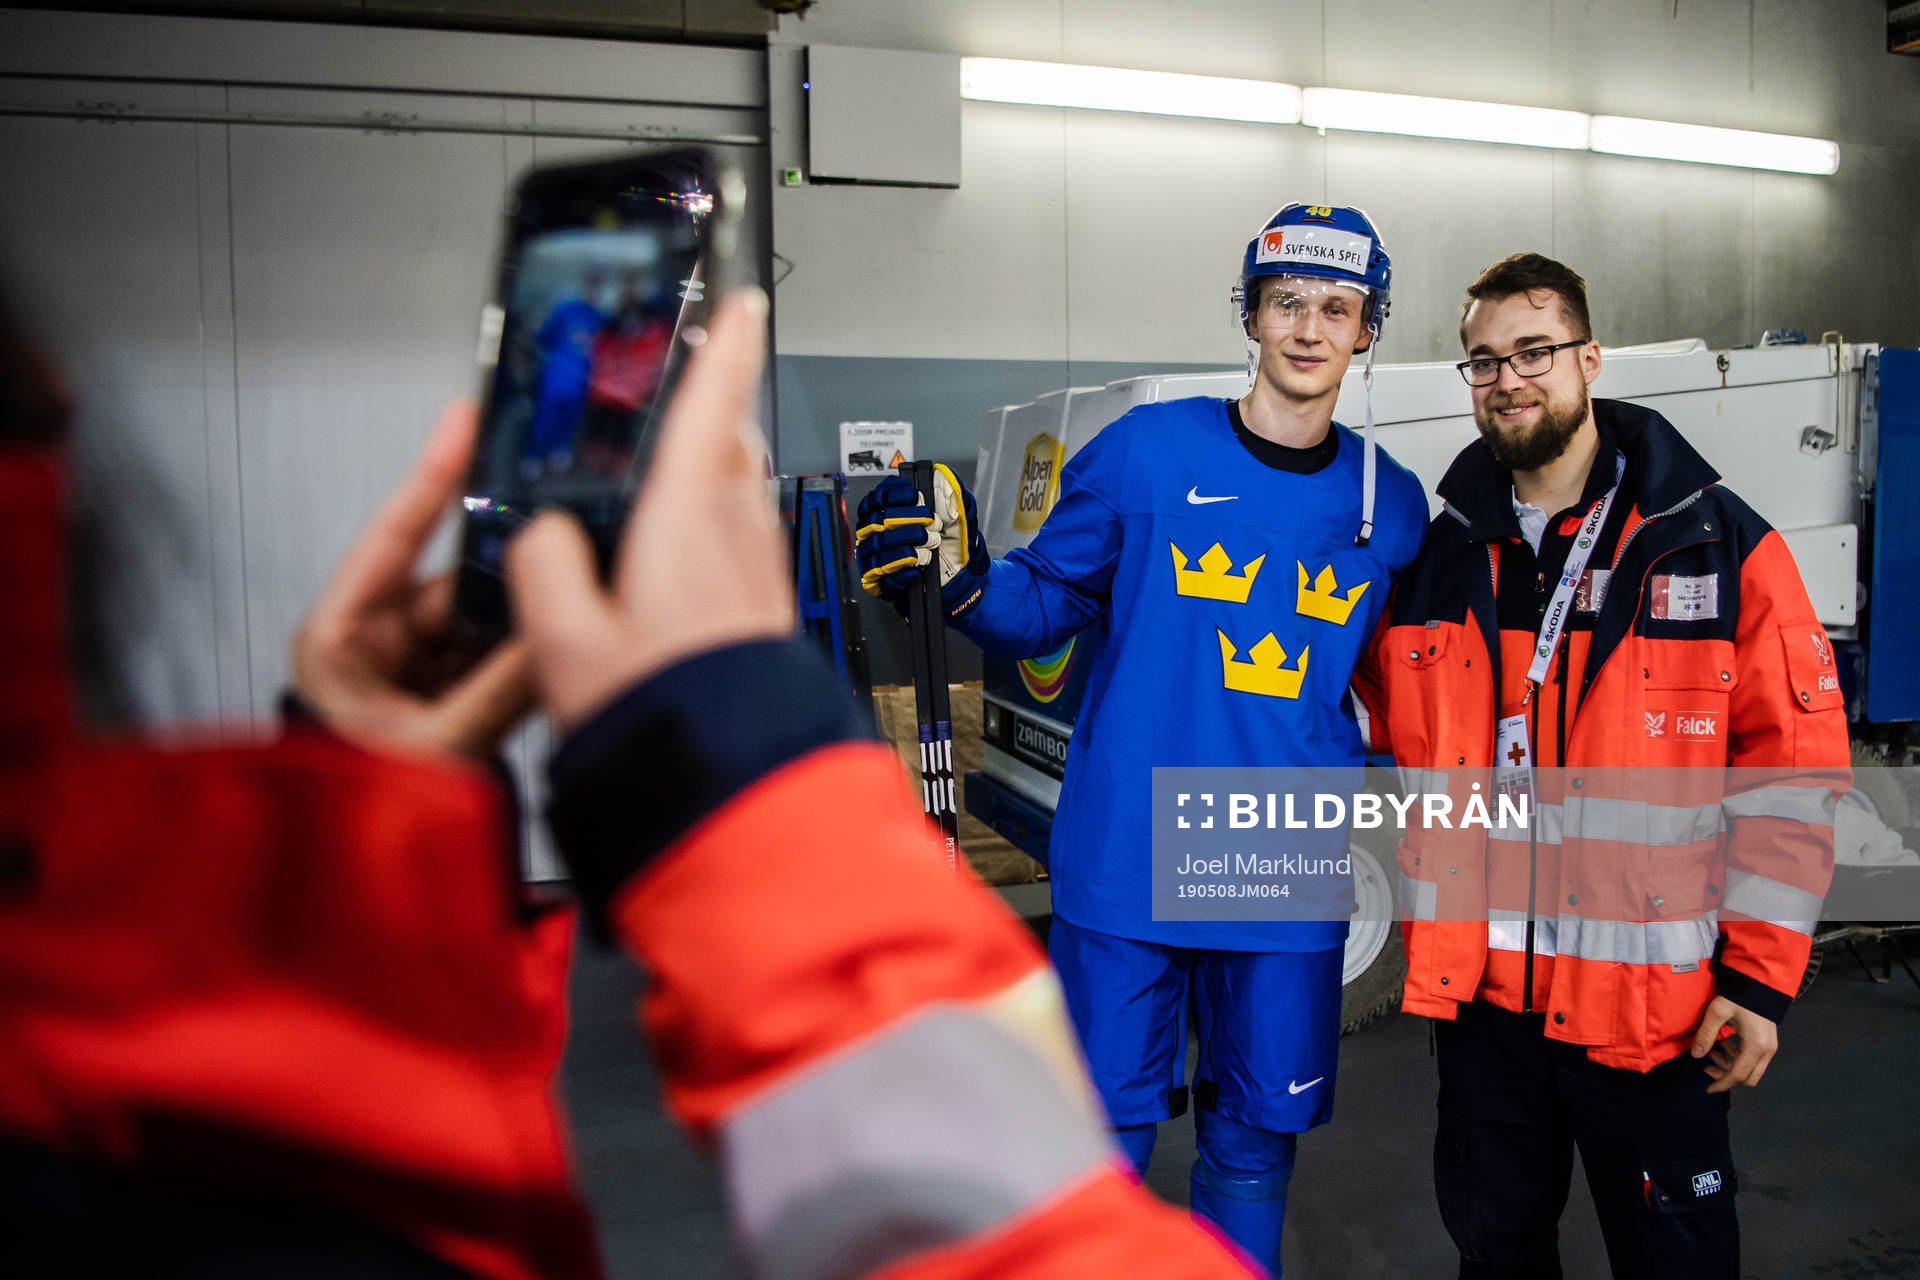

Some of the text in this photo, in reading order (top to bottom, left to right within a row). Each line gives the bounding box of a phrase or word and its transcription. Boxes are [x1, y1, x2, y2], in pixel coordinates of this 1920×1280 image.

[1305, 205, 1332, 217] 40
[1284, 243, 1362, 267] SVENSKA SPEL
[1022, 453, 1053, 490] Alpen
[1020, 481, 1047, 512] Gold
[1586, 495, 1607, 535] ŠKODA
[1544, 600, 1565, 642] ŠKODA
[1676, 716, 1716, 736] Falck
[1018, 722, 1070, 762] ZAMBO
[1695, 1173, 1719, 1189] JNL
